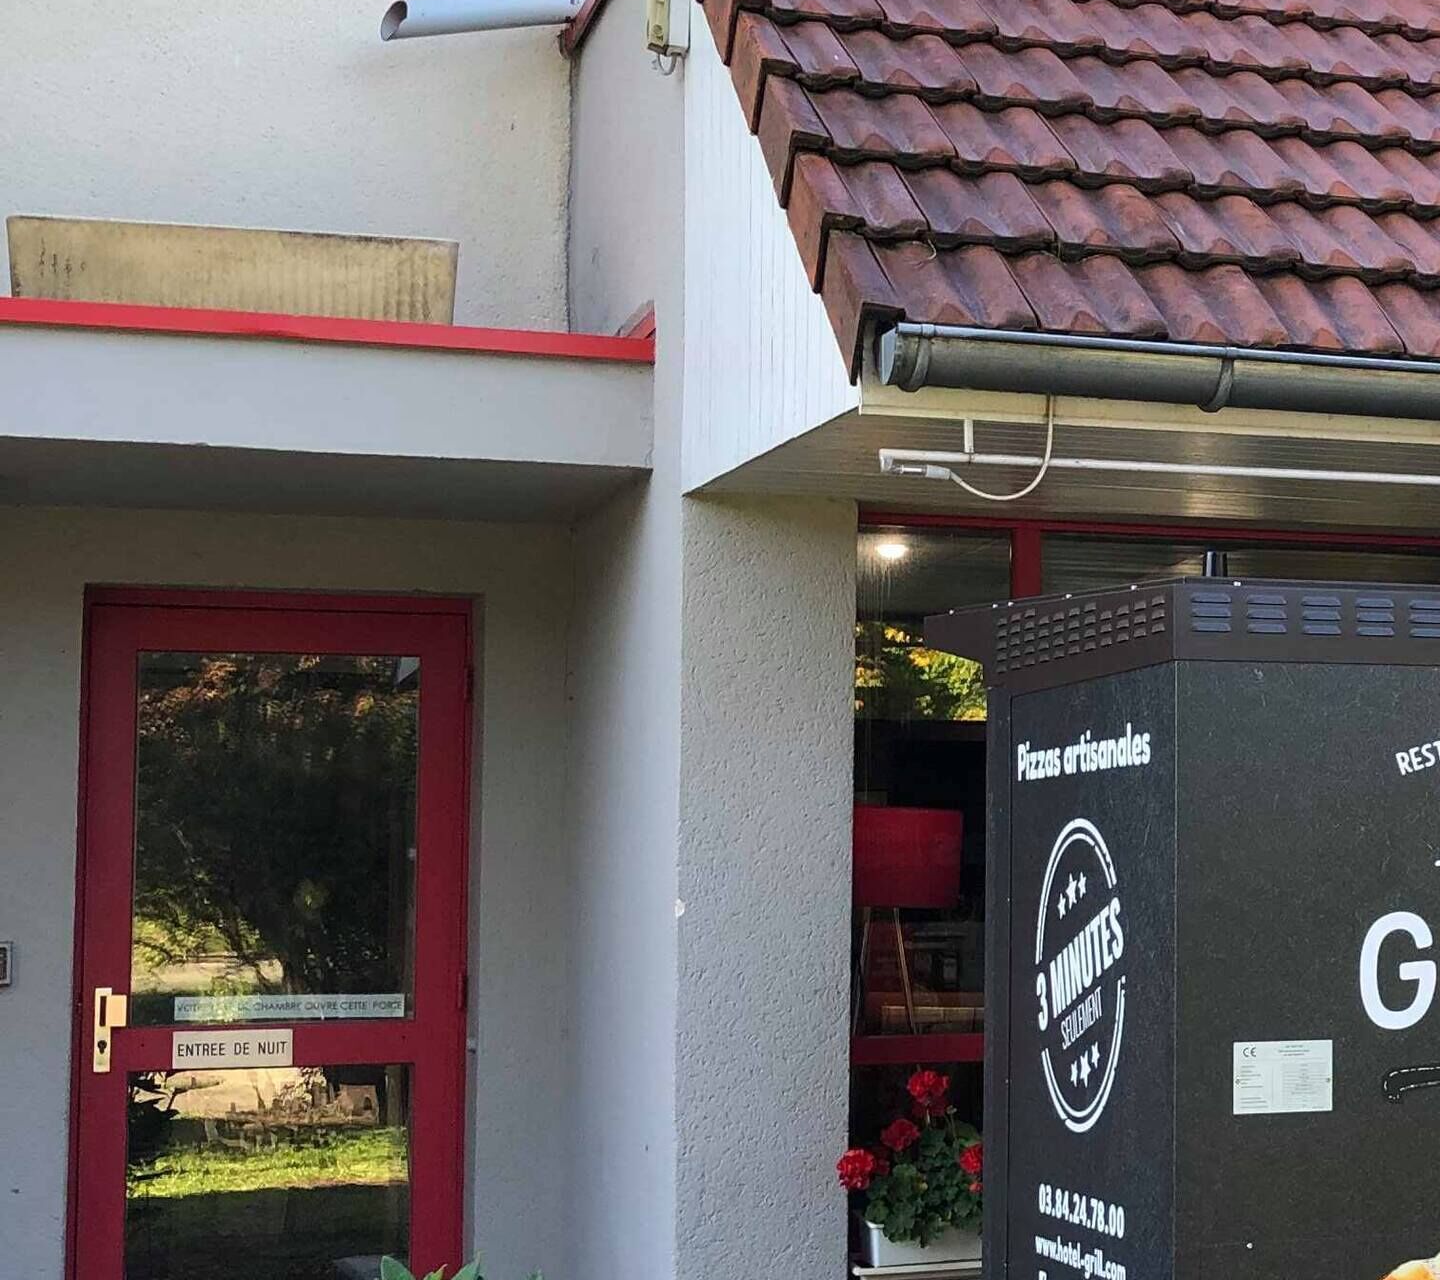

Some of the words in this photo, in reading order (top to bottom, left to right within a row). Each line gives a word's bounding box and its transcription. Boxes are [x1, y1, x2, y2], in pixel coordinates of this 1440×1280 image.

[1017, 740, 1061, 782] Pizzas
[1063, 721, 1151, 775] artisanales
[1036, 971, 1049, 1032] 3
[1049, 896, 1125, 1019] MINUTES
[1060, 985, 1103, 1051] SEULEMENT
[176, 1042, 226, 1058] ENTREE
[233, 1041, 250, 1056] DE
[257, 1040, 289, 1055] NUIT
[1038, 1182, 1126, 1239] 03.84.24.78.00
